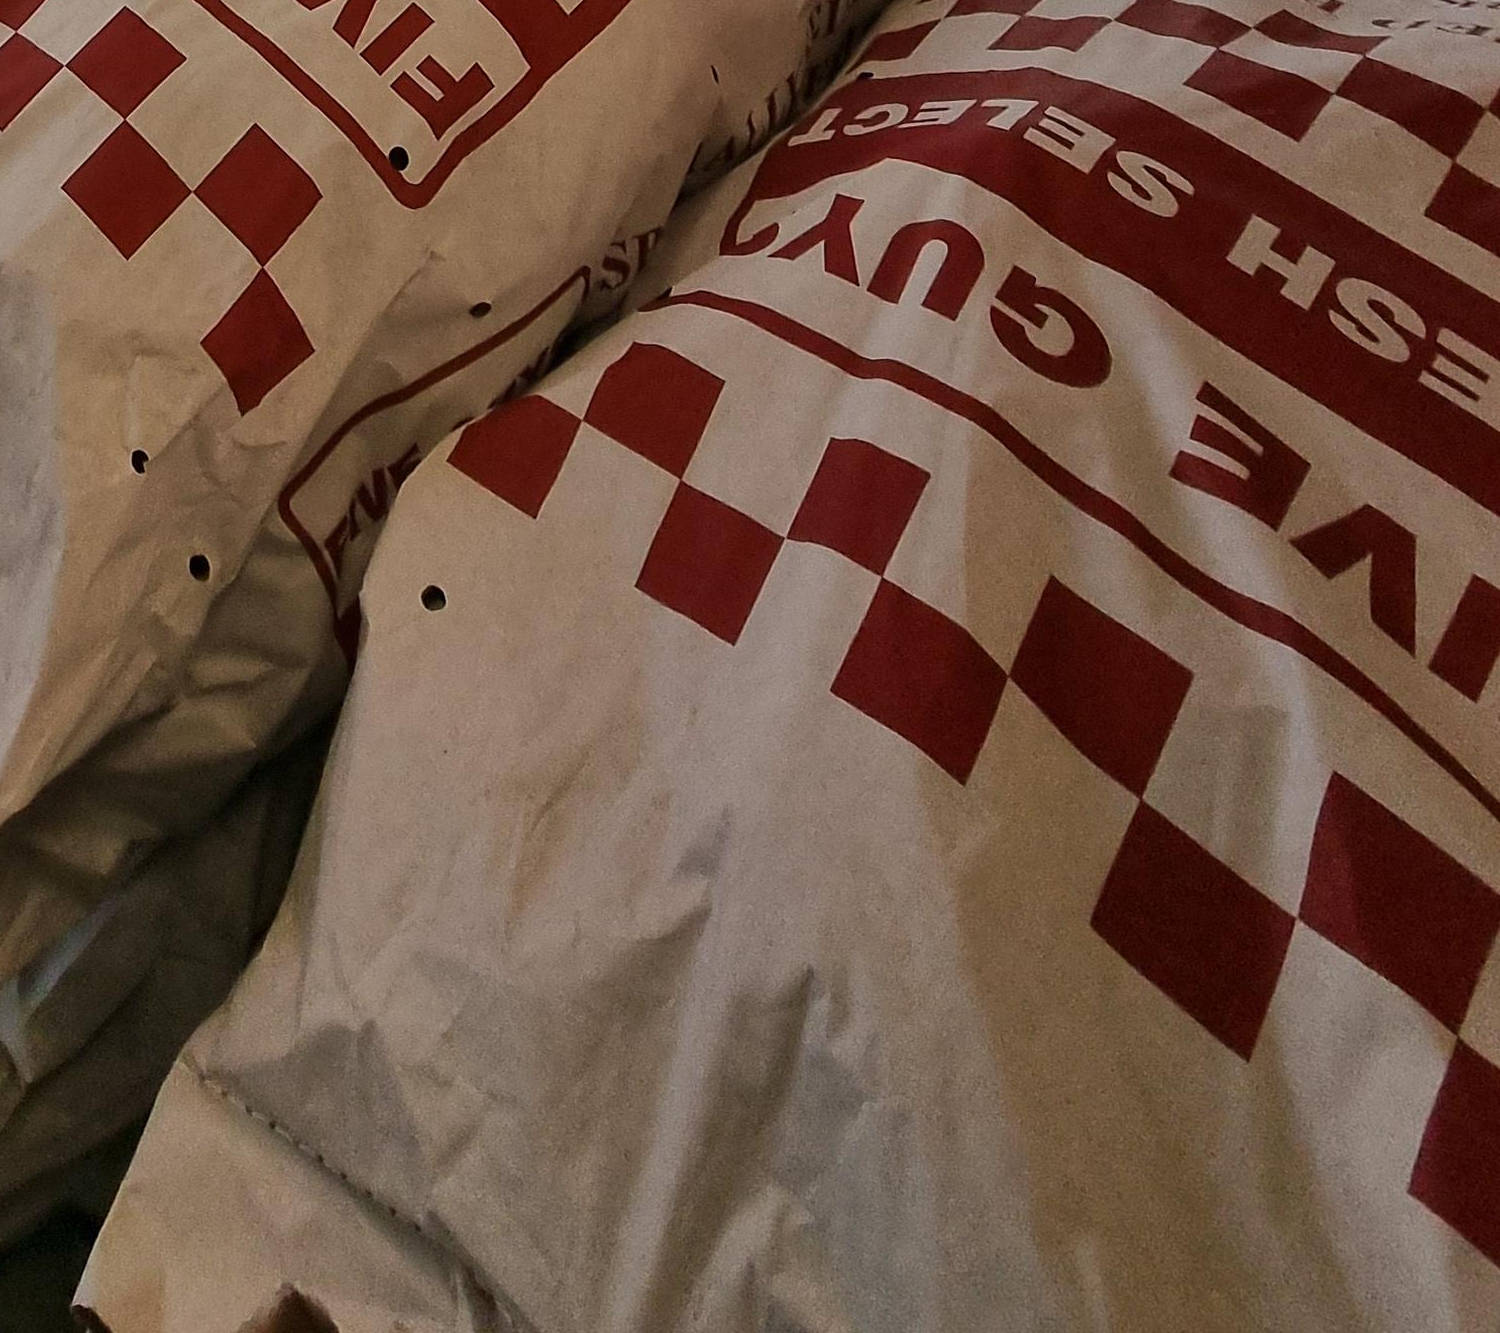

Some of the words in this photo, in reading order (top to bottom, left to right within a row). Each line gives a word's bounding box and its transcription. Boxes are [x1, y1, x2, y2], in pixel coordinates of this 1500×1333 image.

[789, 97, 1196, 220] SELECT
[1225, 212, 1500, 409] ESH
[1170, 380, 1500, 705] IVE
